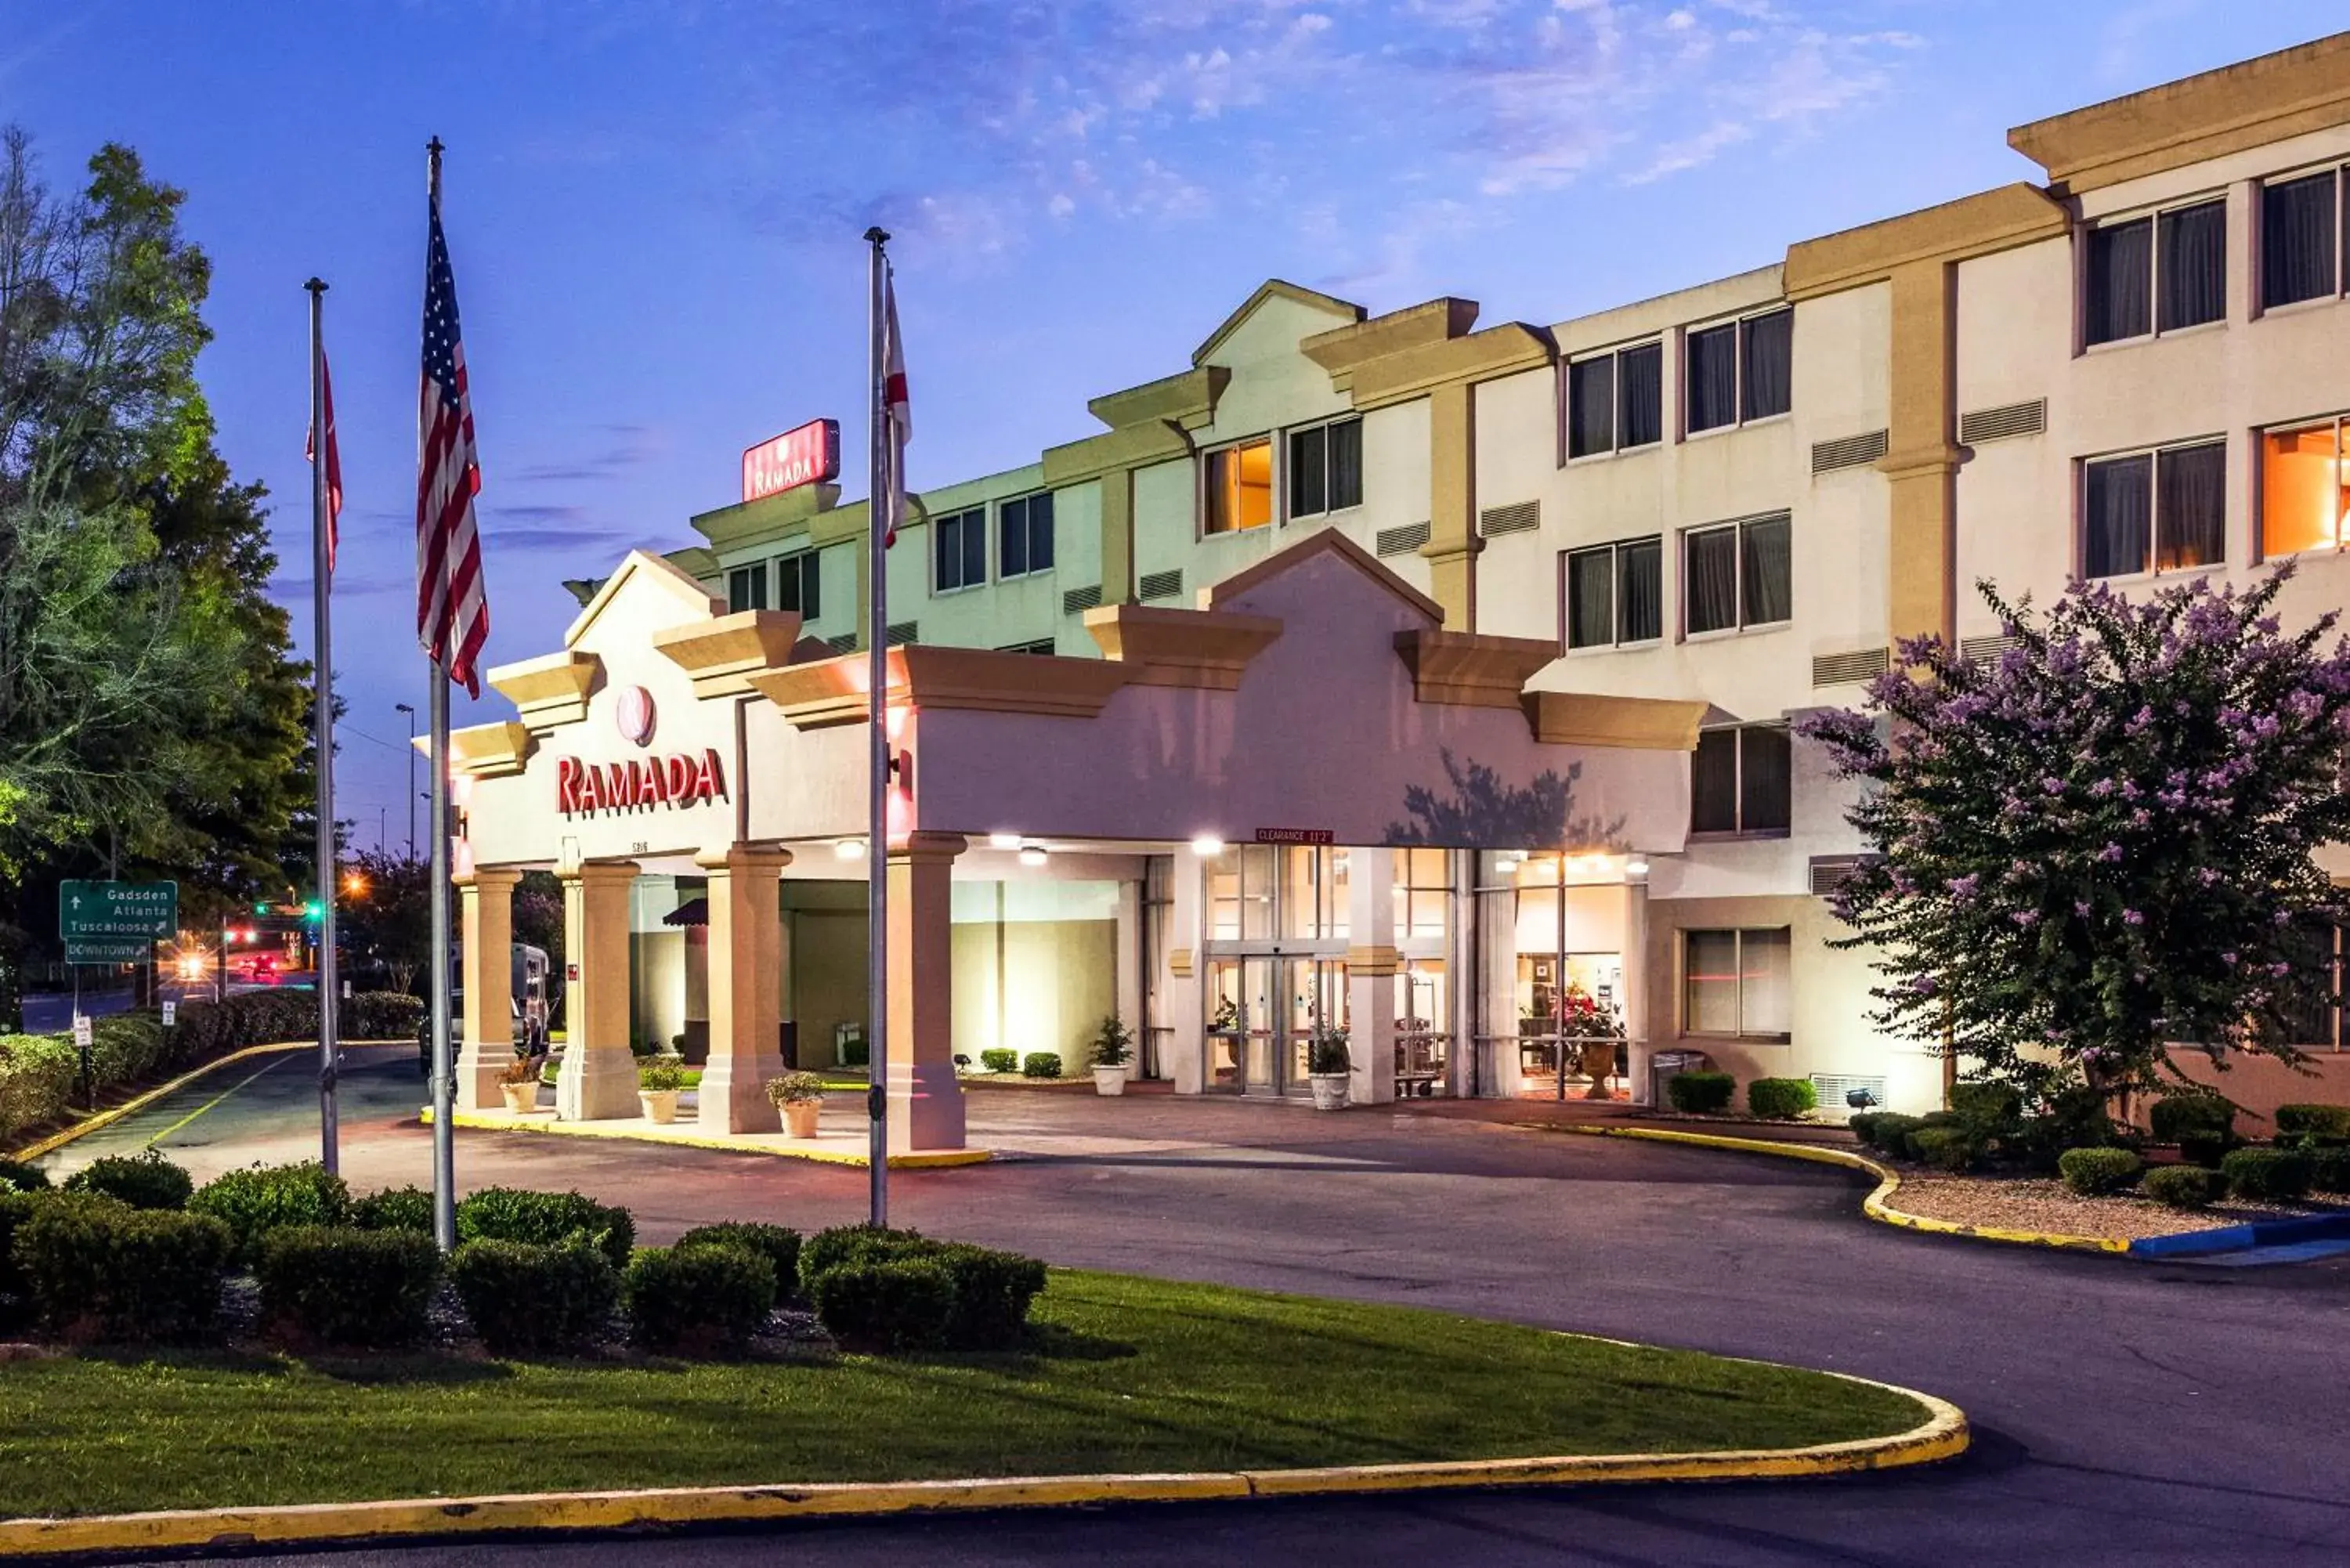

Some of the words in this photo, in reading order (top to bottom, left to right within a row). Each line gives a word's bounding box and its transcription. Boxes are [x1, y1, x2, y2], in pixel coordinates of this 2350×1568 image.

[755, 457, 811, 497] RAMADA
[556, 748, 725, 814] RAMADA
[1258, 830, 1305, 840] CLEARANCE
[107, 889, 168, 900] Gadsden
[114, 905, 168, 916] Atlanta
[70, 920, 150, 932] Tuscaloosa
[68, 944, 135, 955] DOWNTOWN
